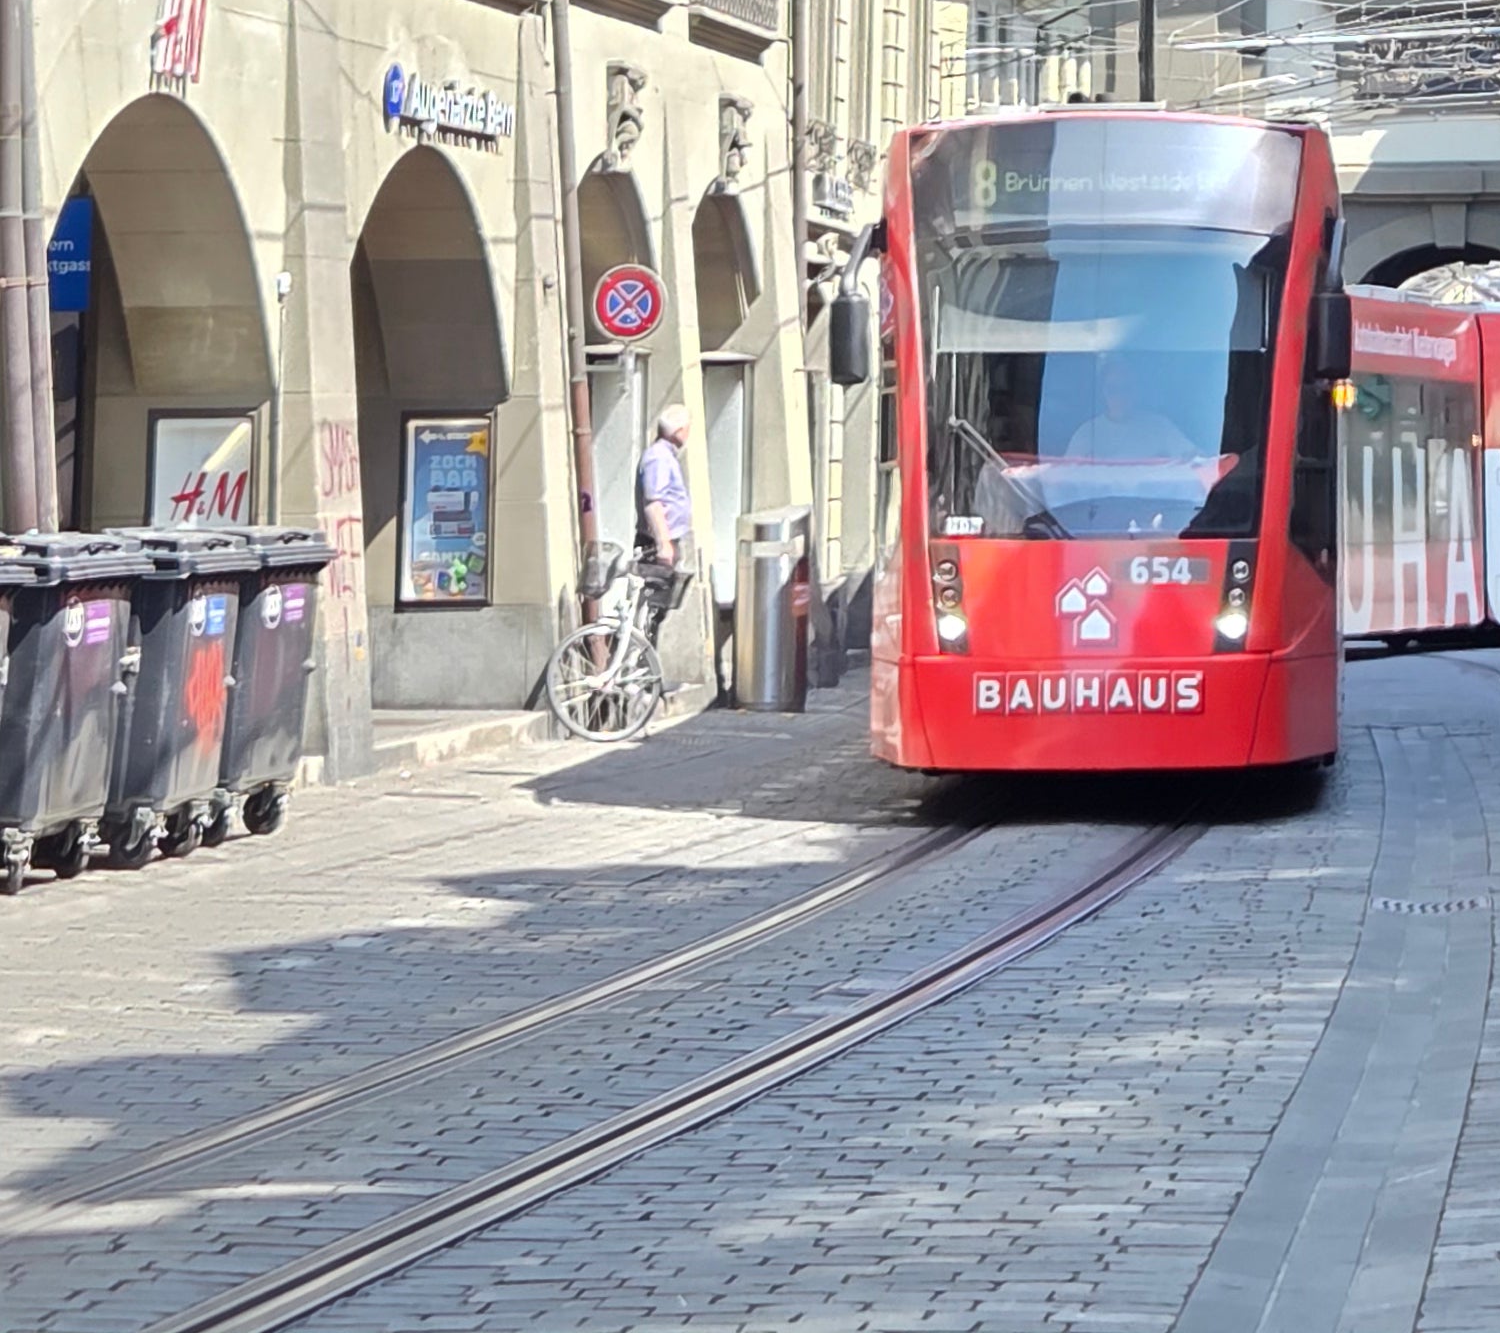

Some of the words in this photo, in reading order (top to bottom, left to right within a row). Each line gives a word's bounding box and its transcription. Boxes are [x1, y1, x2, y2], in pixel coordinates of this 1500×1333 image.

[975, 159, 998, 208] 8
[1004, 171, 1093, 193] Brünnen
[49, 239, 75, 252] ern
[169, 469, 249, 523] H&M
[1129, 557, 1192, 585] 654
[977, 676, 1201, 710] BAUHAUS
